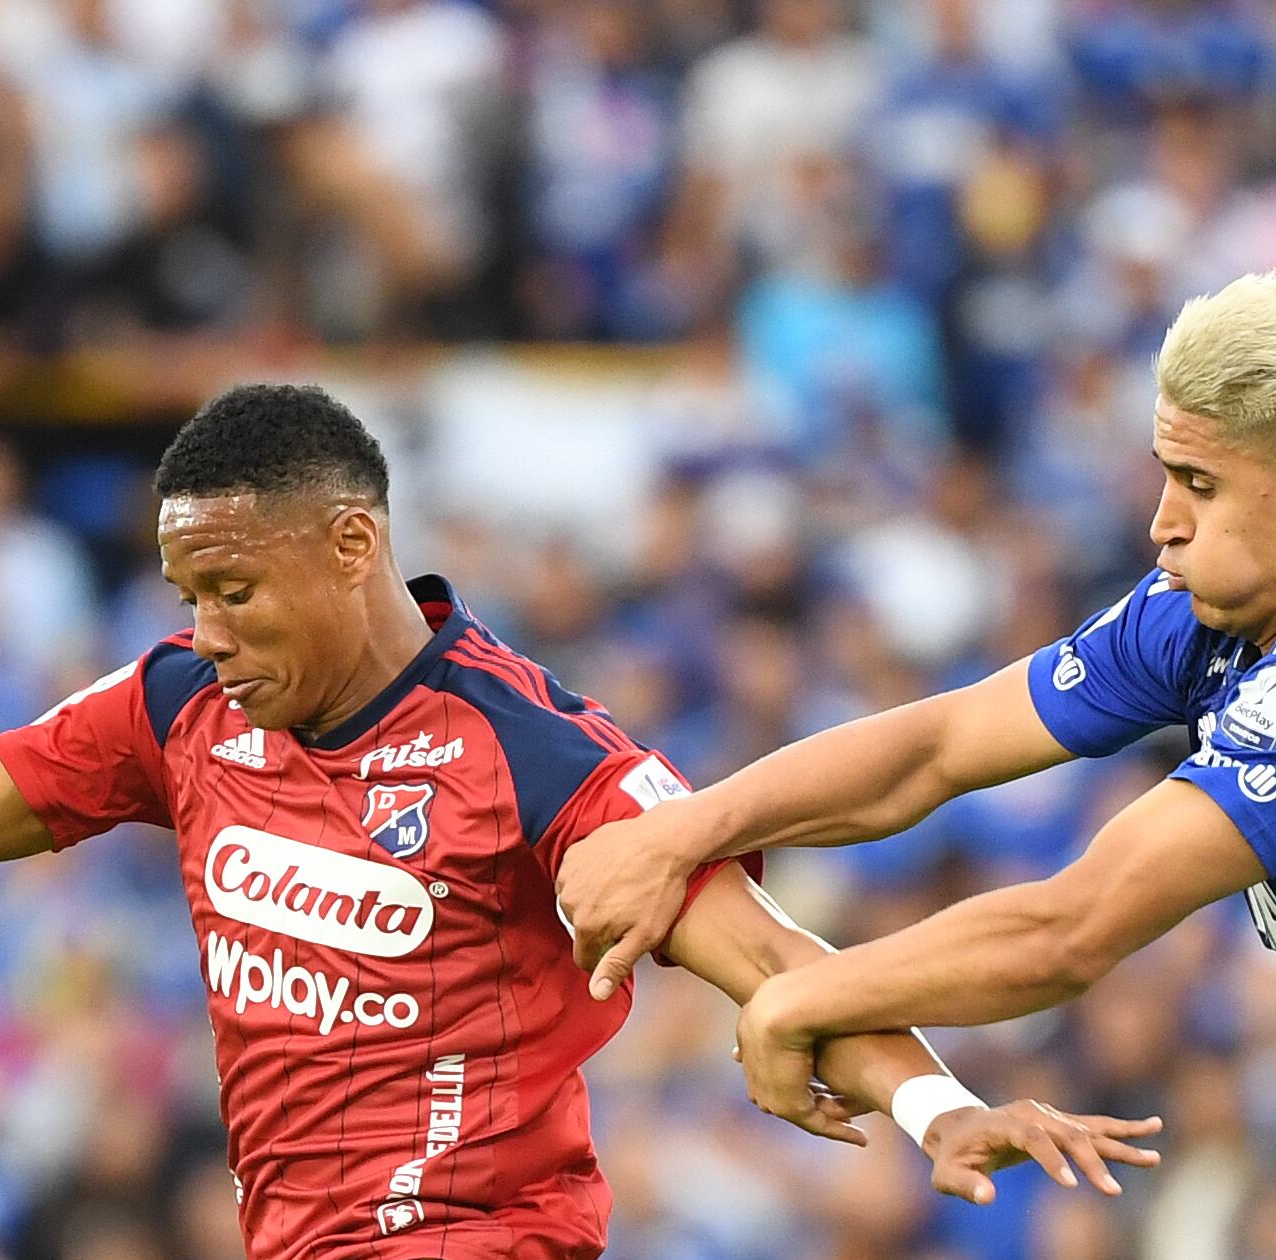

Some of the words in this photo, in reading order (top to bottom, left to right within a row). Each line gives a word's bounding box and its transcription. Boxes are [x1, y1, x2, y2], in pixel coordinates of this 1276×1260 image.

[211, 744, 267, 769] adidas
[212, 843, 423, 936] Colanta
[207, 930, 420, 1037] Wplay.co
